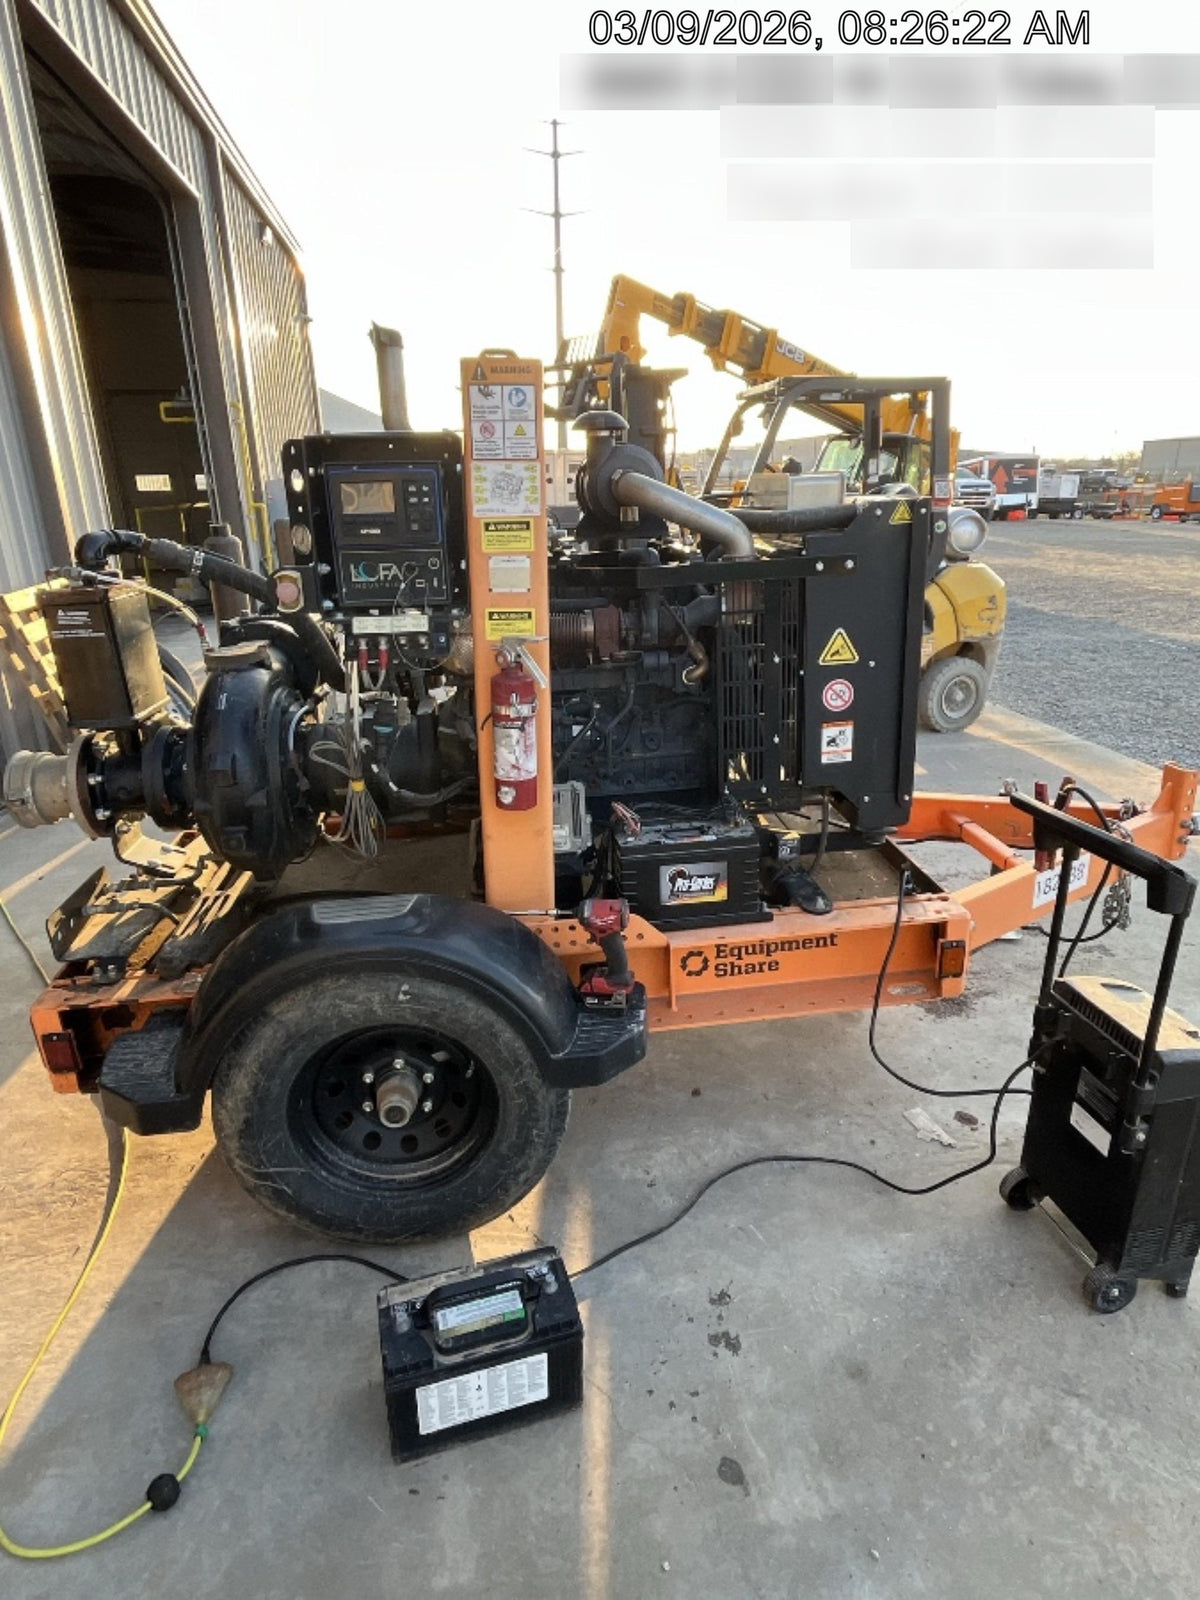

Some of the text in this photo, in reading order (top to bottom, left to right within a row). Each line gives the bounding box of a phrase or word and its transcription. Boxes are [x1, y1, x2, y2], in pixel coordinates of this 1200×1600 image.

[776, 342, 805, 364] JCB
[713, 932, 839, 961] Equipment
[713, 958, 781, 978] Share
